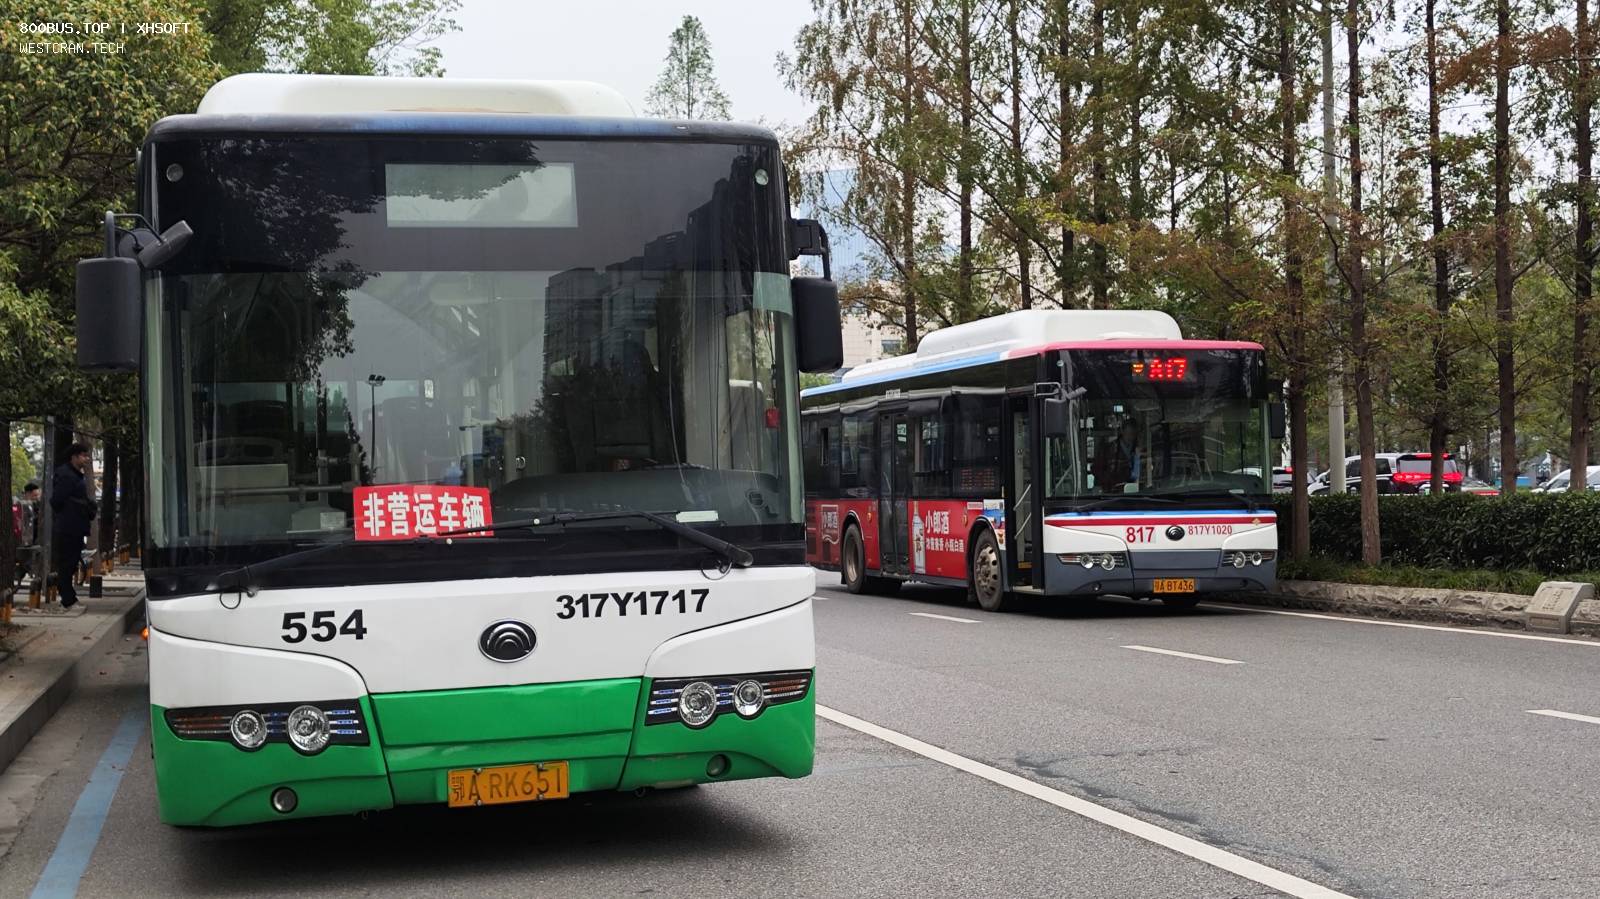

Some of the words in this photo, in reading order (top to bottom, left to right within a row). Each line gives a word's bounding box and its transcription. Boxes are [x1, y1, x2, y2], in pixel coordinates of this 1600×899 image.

[362, 491, 486, 537] 非营运车辆
[1188, 524, 1233, 536] 817Y1020
[1126, 526, 1155, 543] 817
[556, 588, 710, 620] 317Y1717
[281, 609, 367, 643] 554
